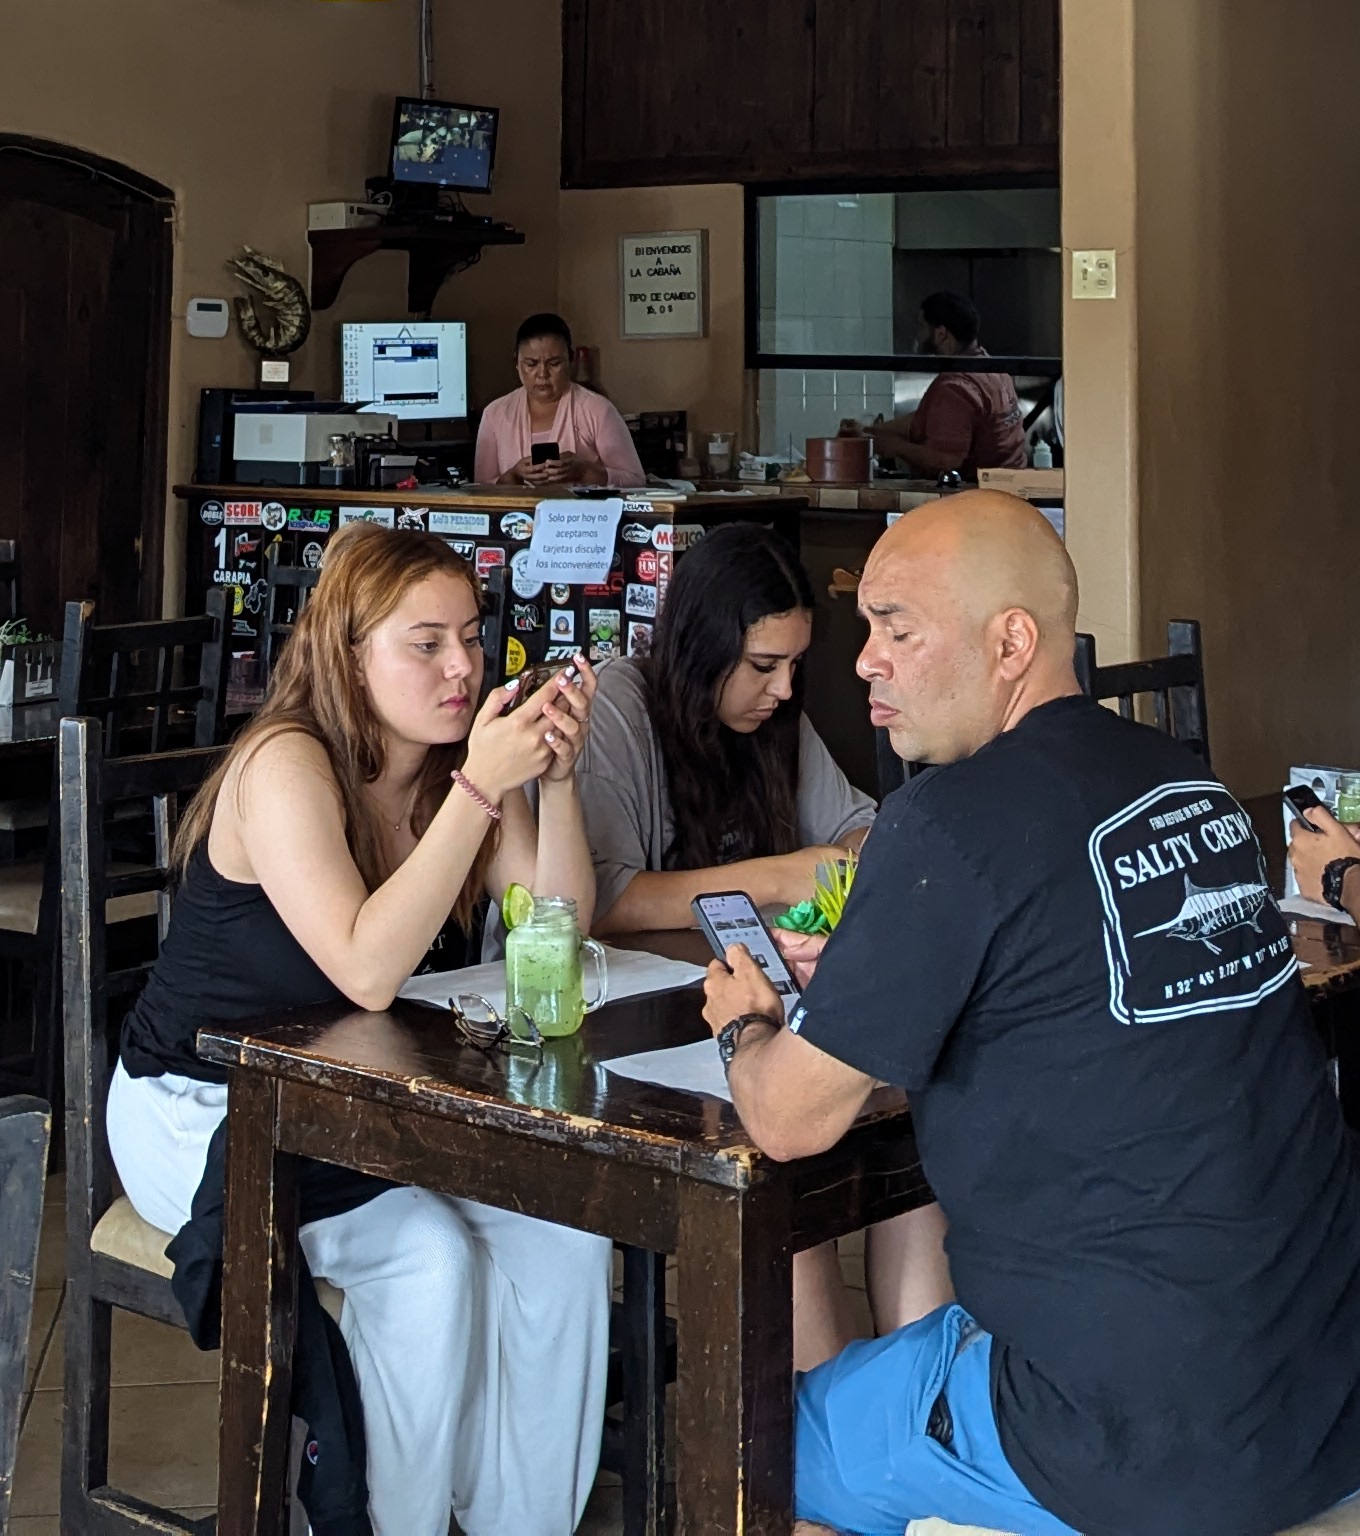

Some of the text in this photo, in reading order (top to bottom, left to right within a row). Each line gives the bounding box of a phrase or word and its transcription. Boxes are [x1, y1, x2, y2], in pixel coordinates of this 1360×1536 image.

[656, 257, 662, 266] A
[630, 264, 681, 278] LA CABAÑA
[629, 291, 696, 302] TIPO DE CAMBIO
[227, 504, 260, 517] SCORE
[549, 513, 608, 524] Solo por hoy no
[556, 529, 598, 539] aceptamos
[214, 527, 227, 569] 1
[543, 544, 606, 555] tarjetas disculpe
[536, 559, 608, 570] los inconvenientes
[213, 569, 251, 585] CARAPIA
[1114, 811, 1253, 890] SALTY CREW
[1165, 984, 1173, 999] N
[1242, 955, 1253, 969] W
